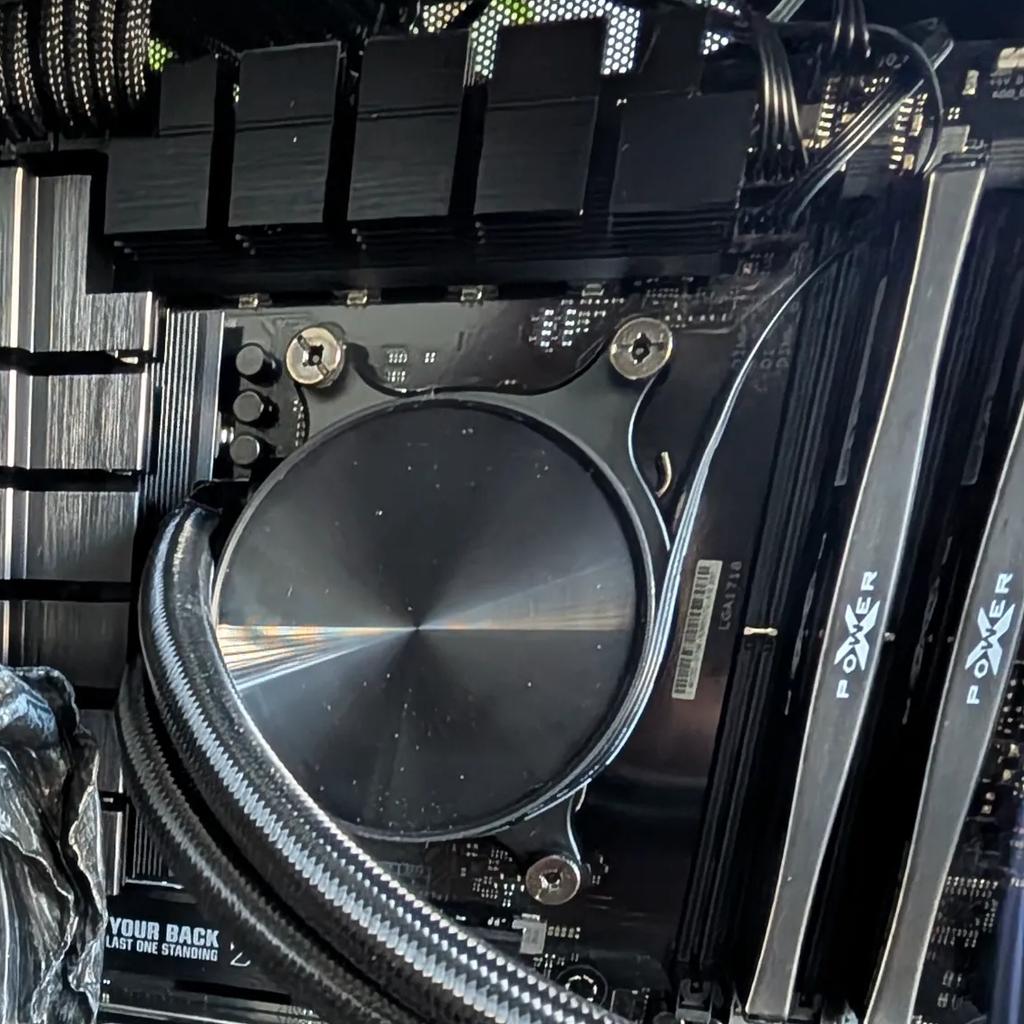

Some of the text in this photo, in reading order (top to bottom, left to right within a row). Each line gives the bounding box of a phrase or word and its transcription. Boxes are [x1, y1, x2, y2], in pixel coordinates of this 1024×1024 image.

[109, 916, 220, 948] YOUR BACK
[105, 935, 219, 962] LAST ONE STANDING
